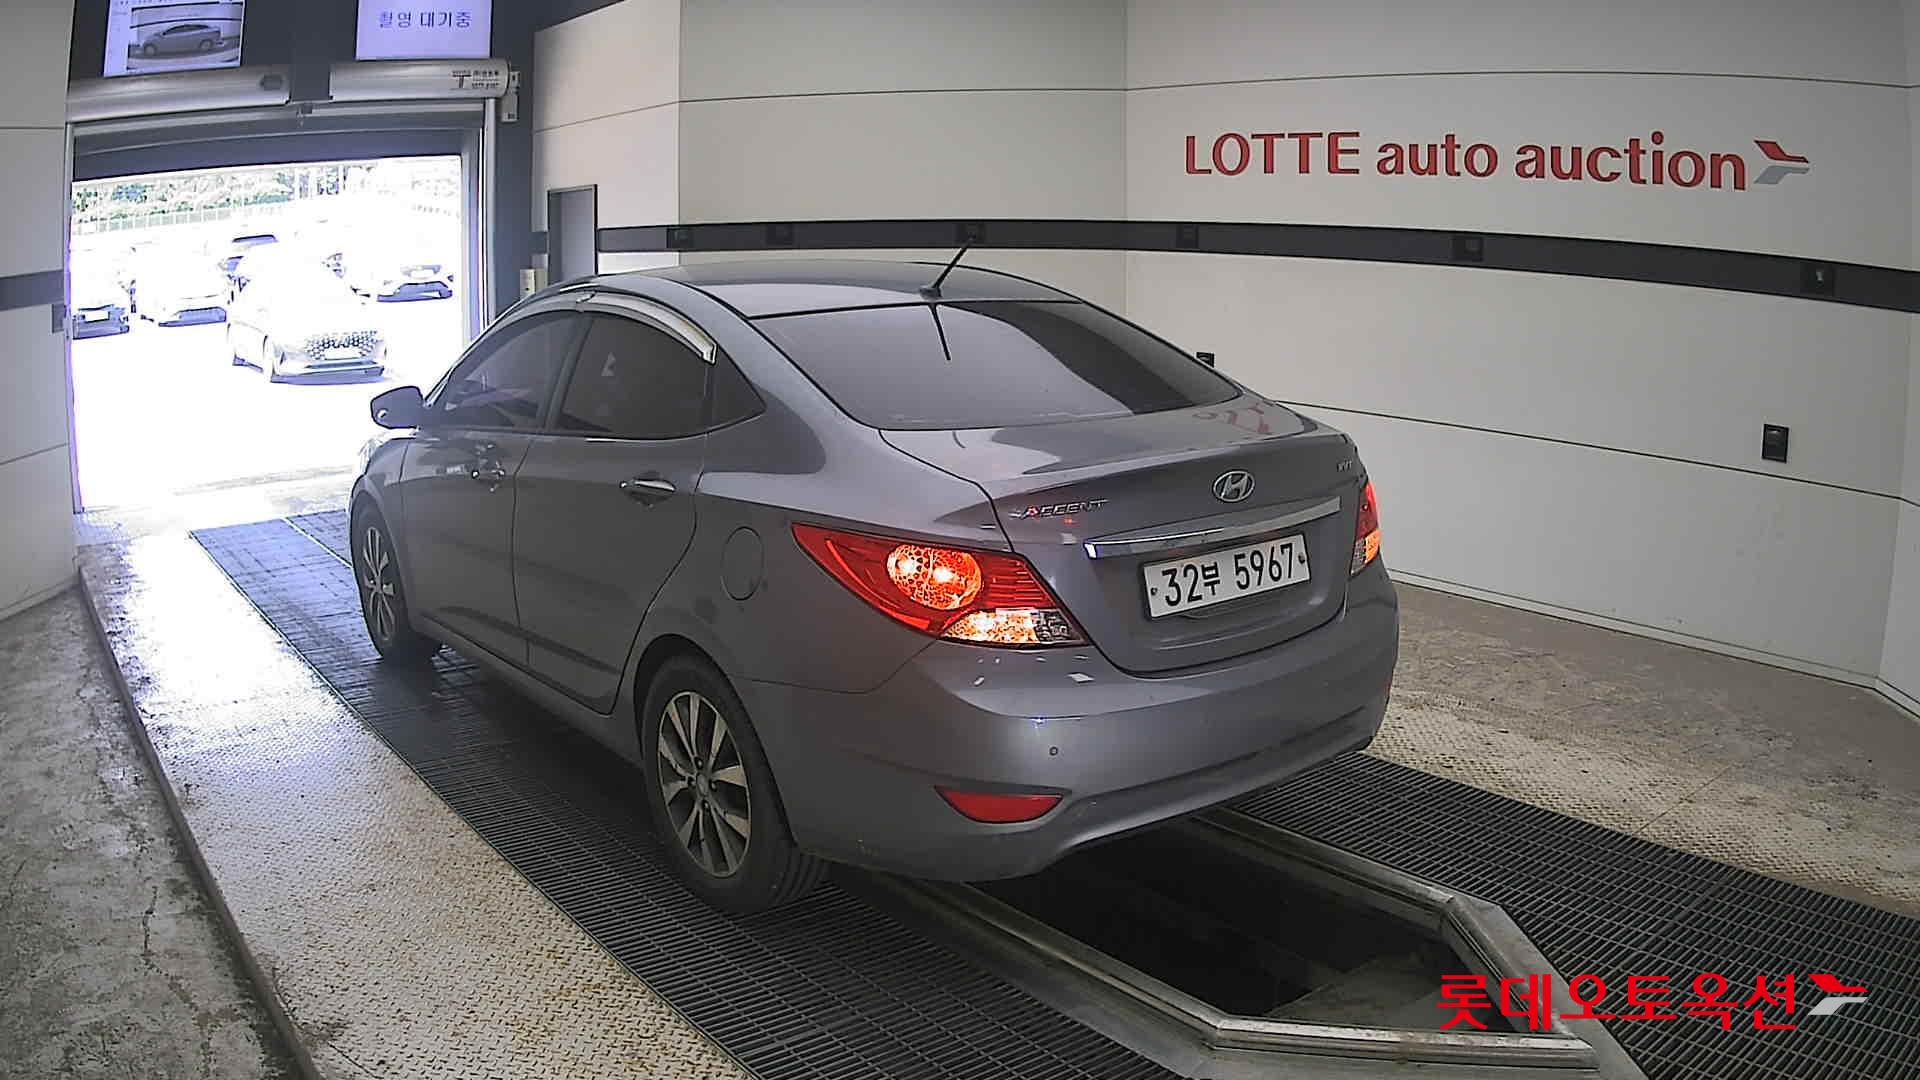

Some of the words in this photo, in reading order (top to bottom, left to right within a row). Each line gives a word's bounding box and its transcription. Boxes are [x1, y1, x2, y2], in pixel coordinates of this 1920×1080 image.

[420, 11, 472, 28] 대기중
[1185, 131, 1360, 175] LOTTE
[1376, 133, 1498, 177] auto
[1515, 130, 1746, 191] auction
[1009, 498, 1109, 520] ACCENT
[1162, 563, 1221, 607] 32부
[1233, 543, 1294, 590] 5967
